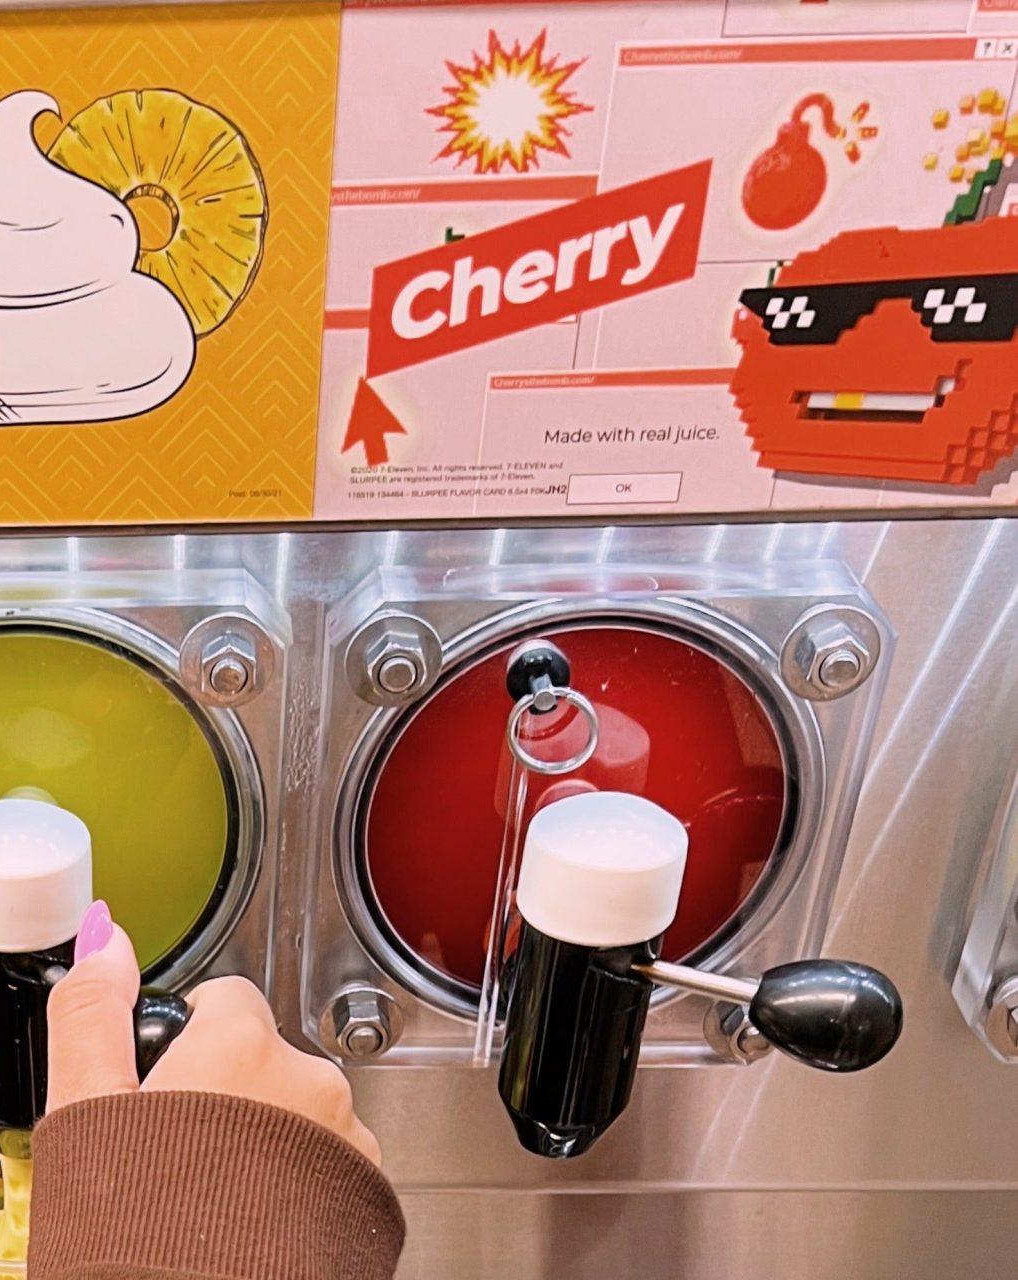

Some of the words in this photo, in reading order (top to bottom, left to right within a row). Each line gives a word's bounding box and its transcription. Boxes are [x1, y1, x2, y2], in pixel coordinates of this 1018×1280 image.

[391, 203, 685, 339] Cherry
[544, 428, 592, 444] Made
[597, 426, 635, 442] with
[639, 425, 671, 441] real
[673, 425, 720, 444] juice.
[432, 464, 442, 472] All
[444, 464, 466, 473] rights
[548, 462, 563, 470] and
[350, 476, 388, 484] SLURPEE
[403, 475, 442, 484] registered
[444, 474, 488, 482] trademarks
[411, 489, 448, 497] SLURPEE
[450, 488, 481, 496] FLAVOR
[483, 487, 506, 496] CARD
[615, 483, 632, 493] OK
